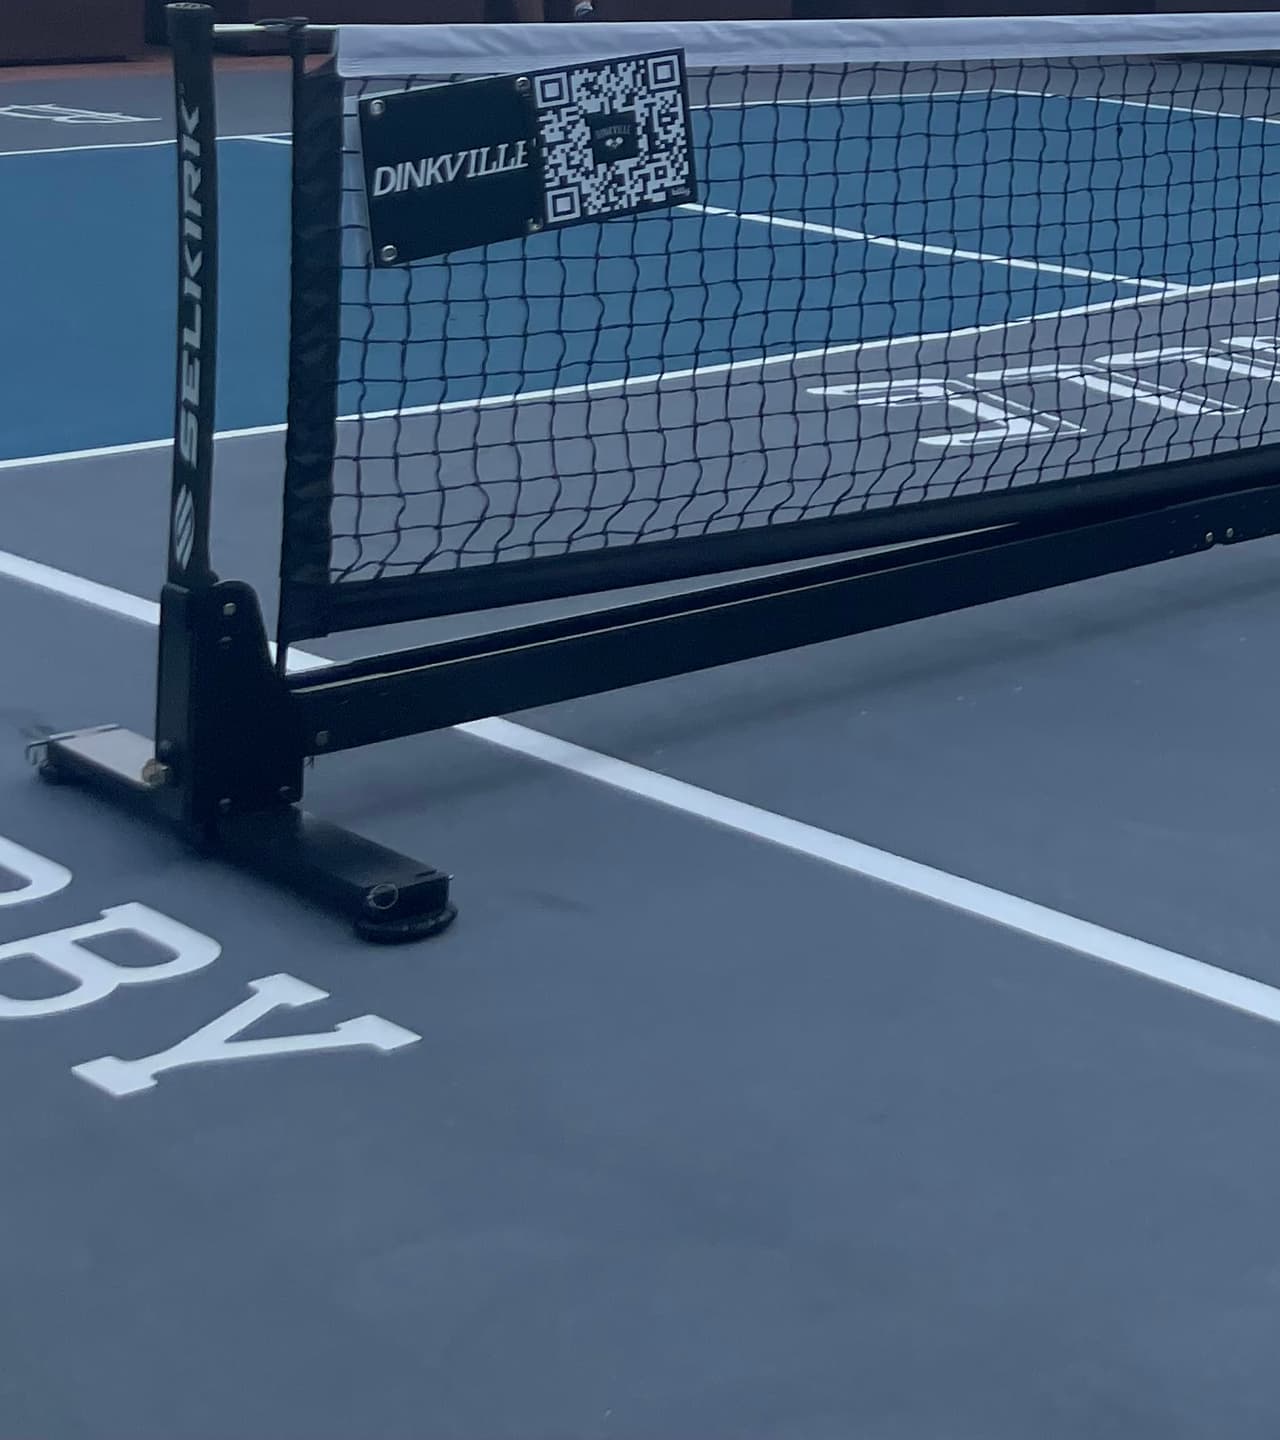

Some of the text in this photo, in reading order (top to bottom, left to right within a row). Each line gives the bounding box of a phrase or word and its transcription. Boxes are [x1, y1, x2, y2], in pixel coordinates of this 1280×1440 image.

[179, 96, 203, 469] SELKIRK
[371, 137, 538, 197] DINKVILLE
[0, 835, 423, 1096] BY
